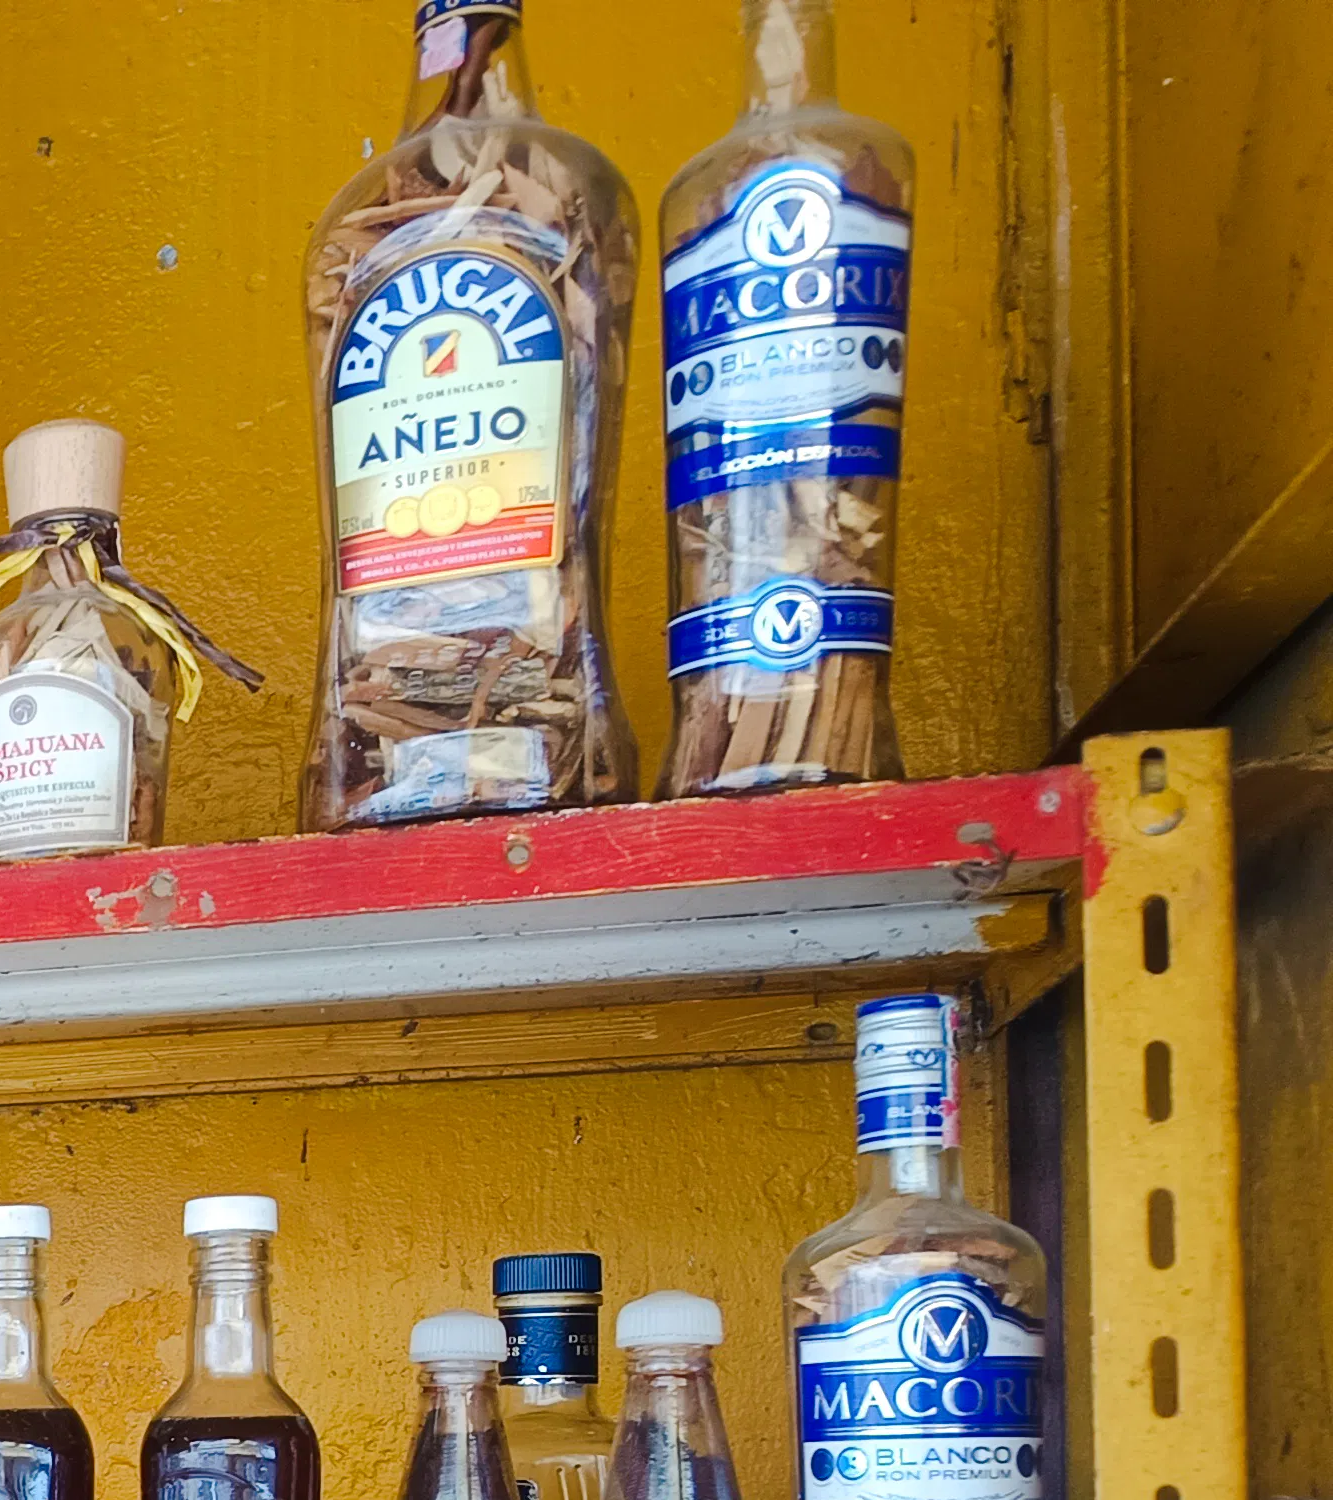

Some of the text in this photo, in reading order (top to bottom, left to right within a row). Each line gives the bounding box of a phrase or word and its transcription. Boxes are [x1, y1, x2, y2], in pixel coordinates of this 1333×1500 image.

[338, 259, 553, 389] BRUGAL
[721, 337, 856, 374] BLANCO
[382, 378, 505, 410] RON DOMINICANO
[358, 405, 527, 470] AÑEJO
[395, 459, 491, 490] SUPERIOR
[52, 780, 96, 792] ESPECIAS
[876, 1445, 1012, 1467] BLANCO
[876, 1468, 1012, 1482] RON PREMIUM
